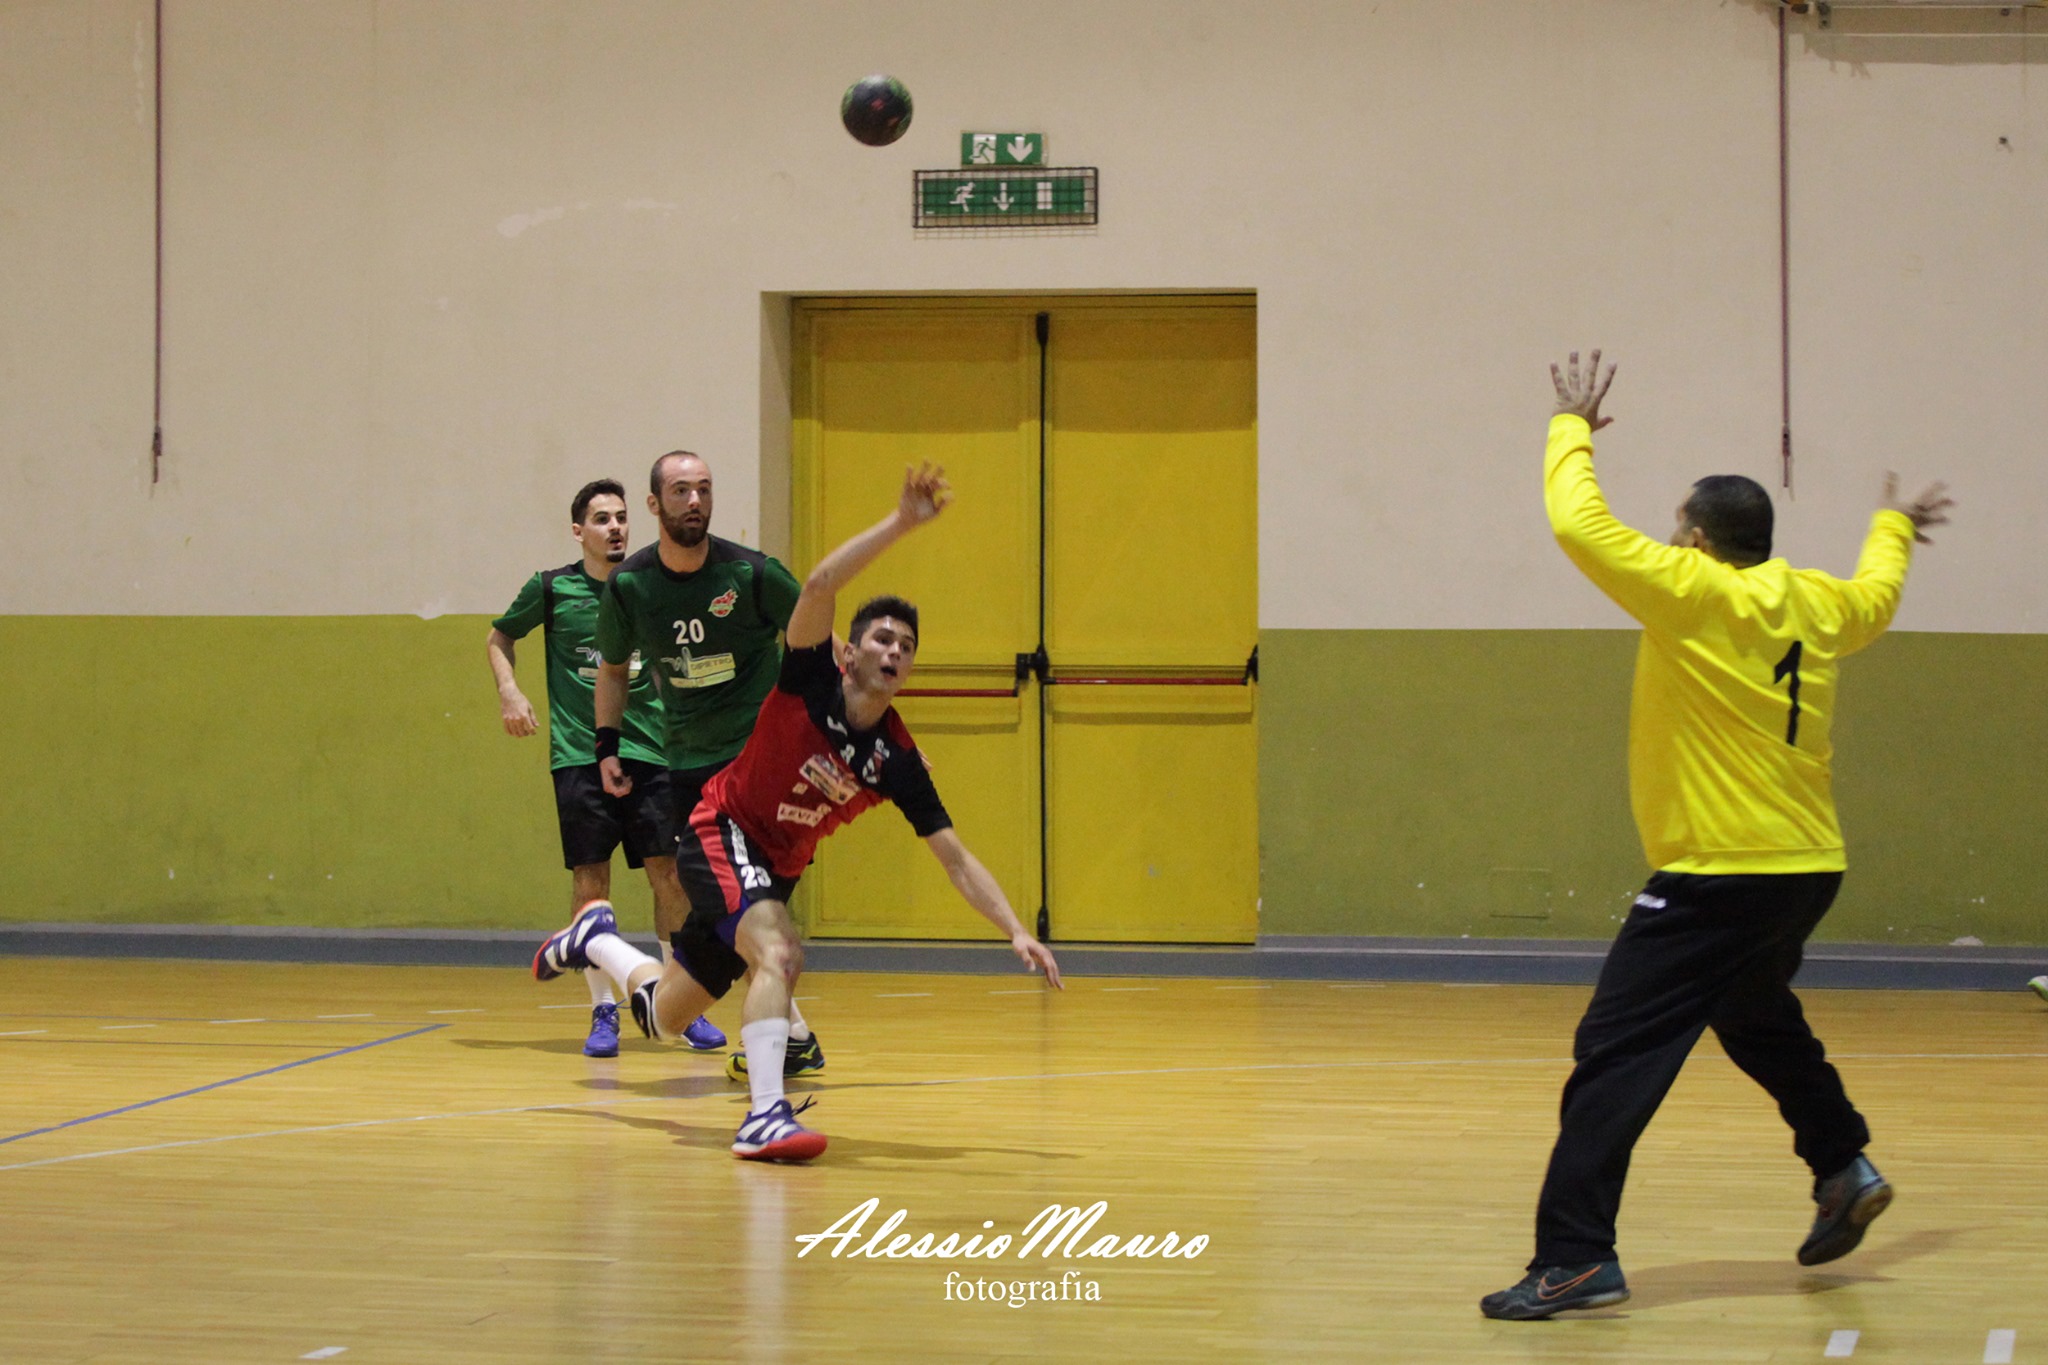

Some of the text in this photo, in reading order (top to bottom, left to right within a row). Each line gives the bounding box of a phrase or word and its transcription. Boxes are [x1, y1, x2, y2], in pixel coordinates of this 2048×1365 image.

[673, 618, 705, 644] 20
[1773, 640, 1802, 746] 1
[741, 865, 772, 890] 23
